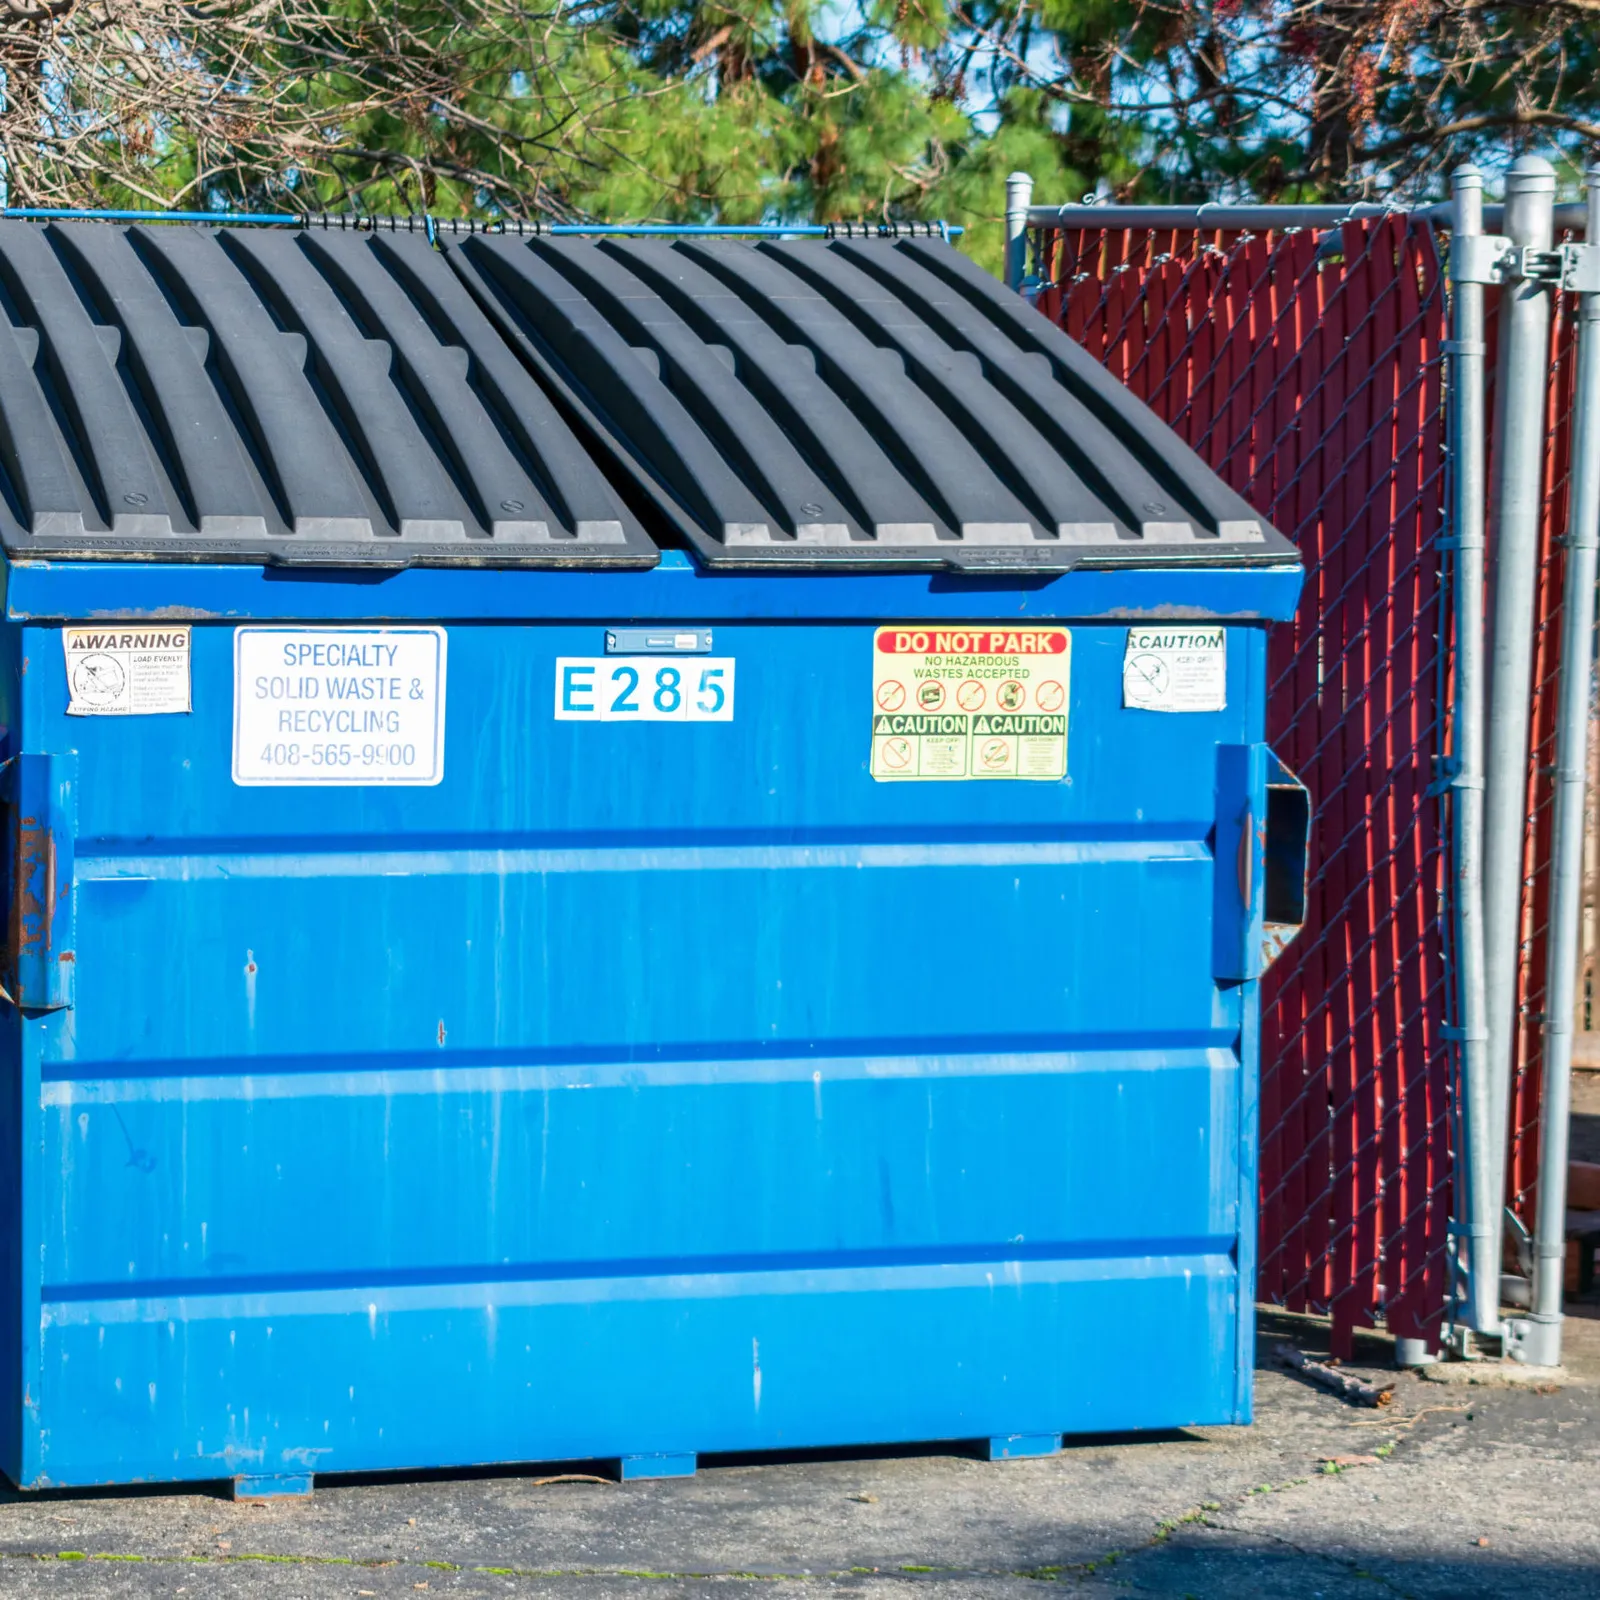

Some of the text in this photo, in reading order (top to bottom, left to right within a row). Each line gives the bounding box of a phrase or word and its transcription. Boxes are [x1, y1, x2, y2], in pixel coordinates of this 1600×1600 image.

[87, 633, 186, 649] WARNING
[894, 632, 1053, 653] DO NOT PARK
[1139, 635, 1221, 649] CAUTION
[133, 655, 152, 663] LOAD
[283, 643, 398, 667] SPECIALTY
[924, 656, 1020, 666] NO HAZARDOUS
[913, 668, 1031, 679] WASTES ACCEPTED
[255, 676, 424, 700] SOLID WASTE &
[562, 666, 725, 713] E285
[278, 710, 400, 733] RECYCLING
[892, 715, 967, 733] CAUTION
[990, 715, 1064, 733] CAUTION
[260, 743, 416, 766] 408-565-9900
